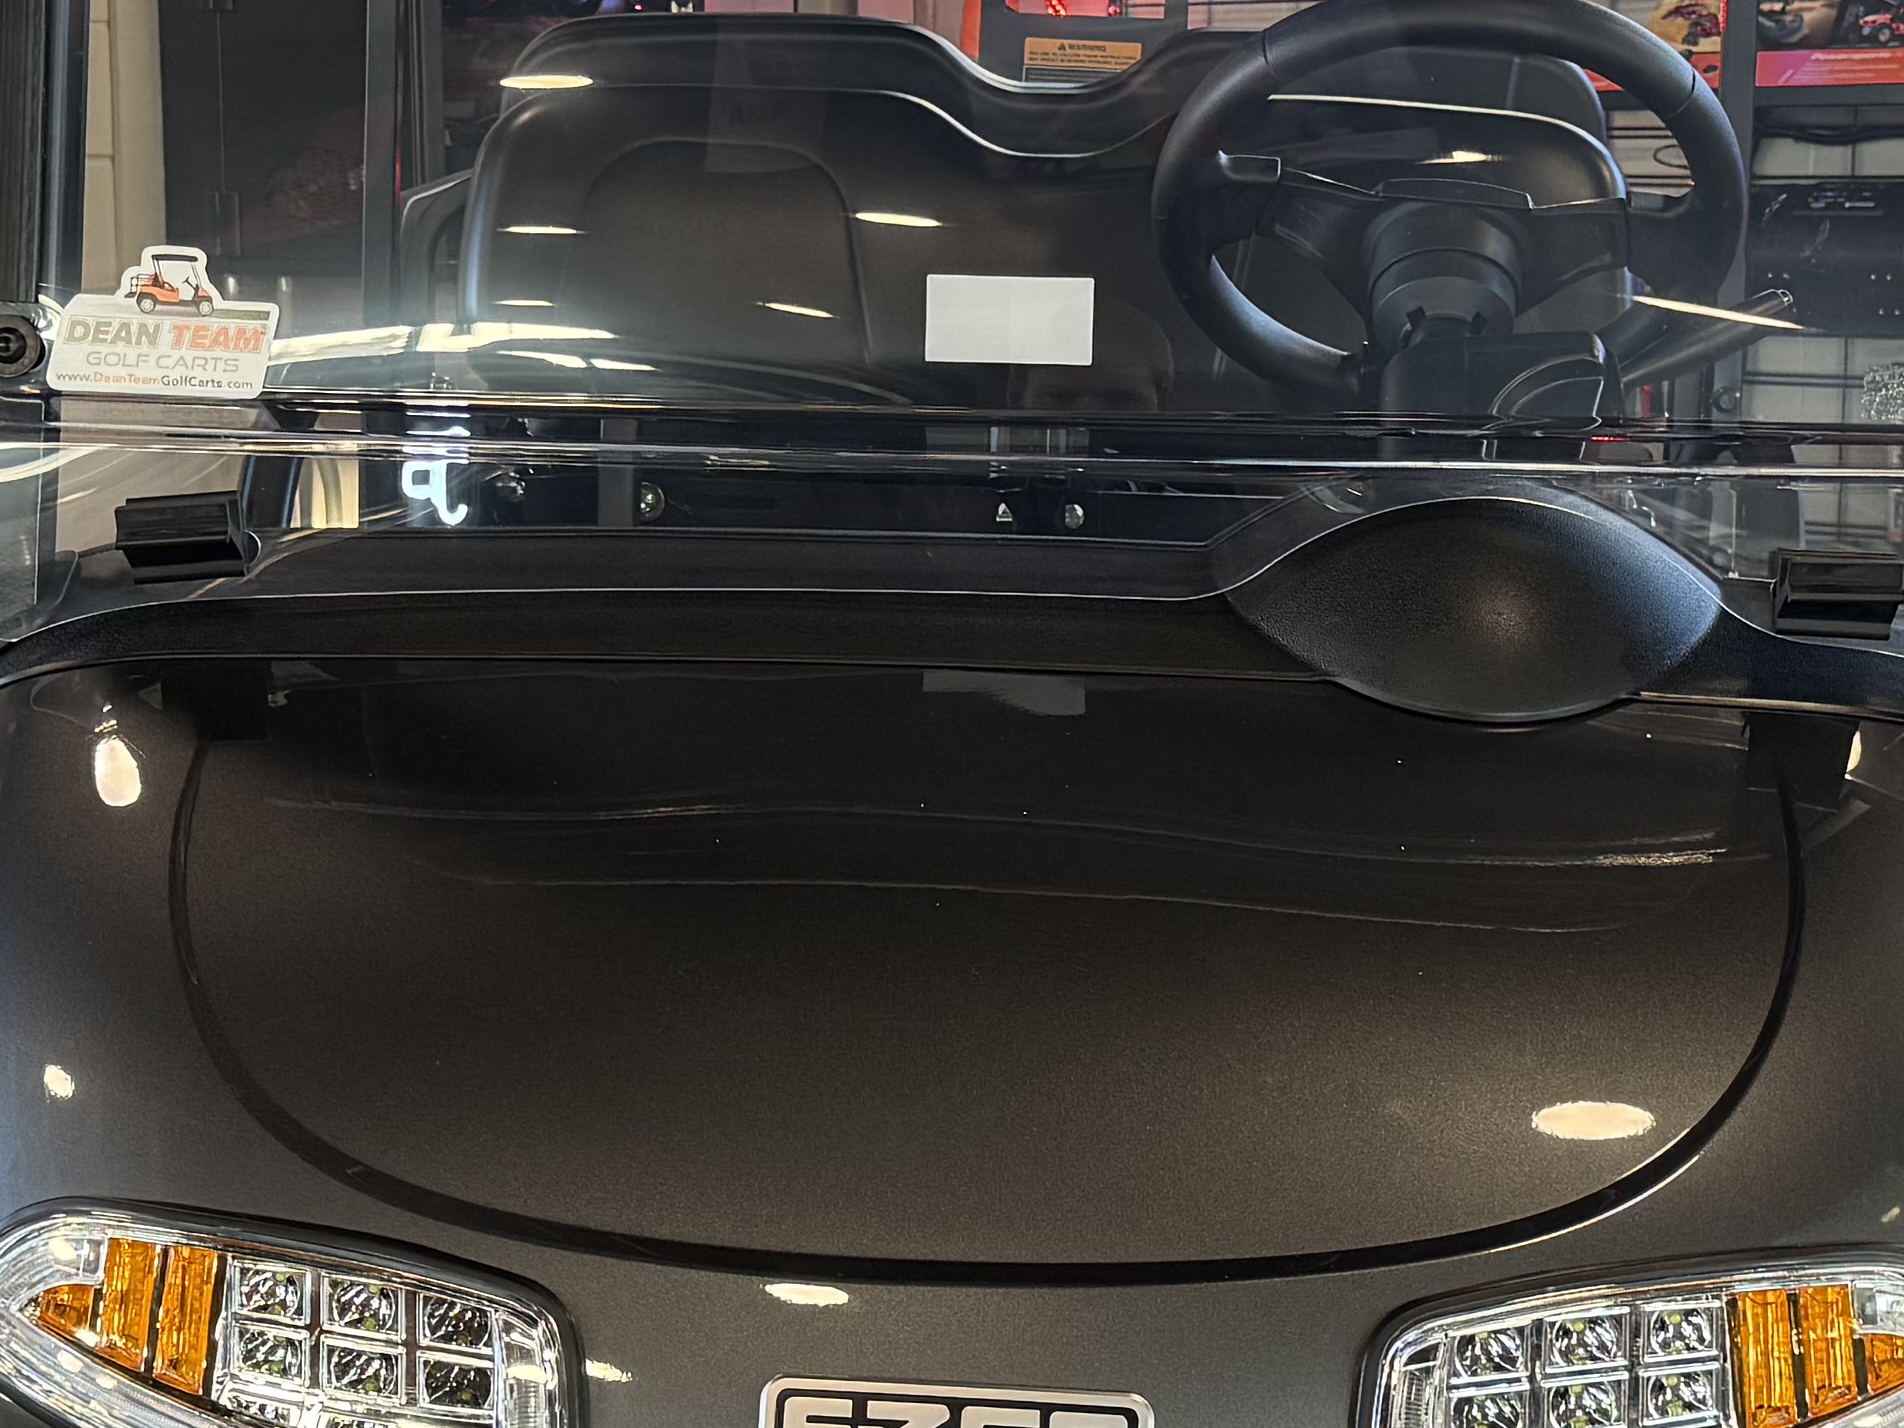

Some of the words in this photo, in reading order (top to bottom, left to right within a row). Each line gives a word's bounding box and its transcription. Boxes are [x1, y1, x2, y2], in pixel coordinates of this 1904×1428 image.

[63, 318, 161, 347] DEAN
[171, 323, 266, 354] TEAM
[86, 351, 151, 368] GOLF
[156, 354, 240, 372] CARTS
[56, 371, 254, 390] www.DeanTeamGolfCarts.com
